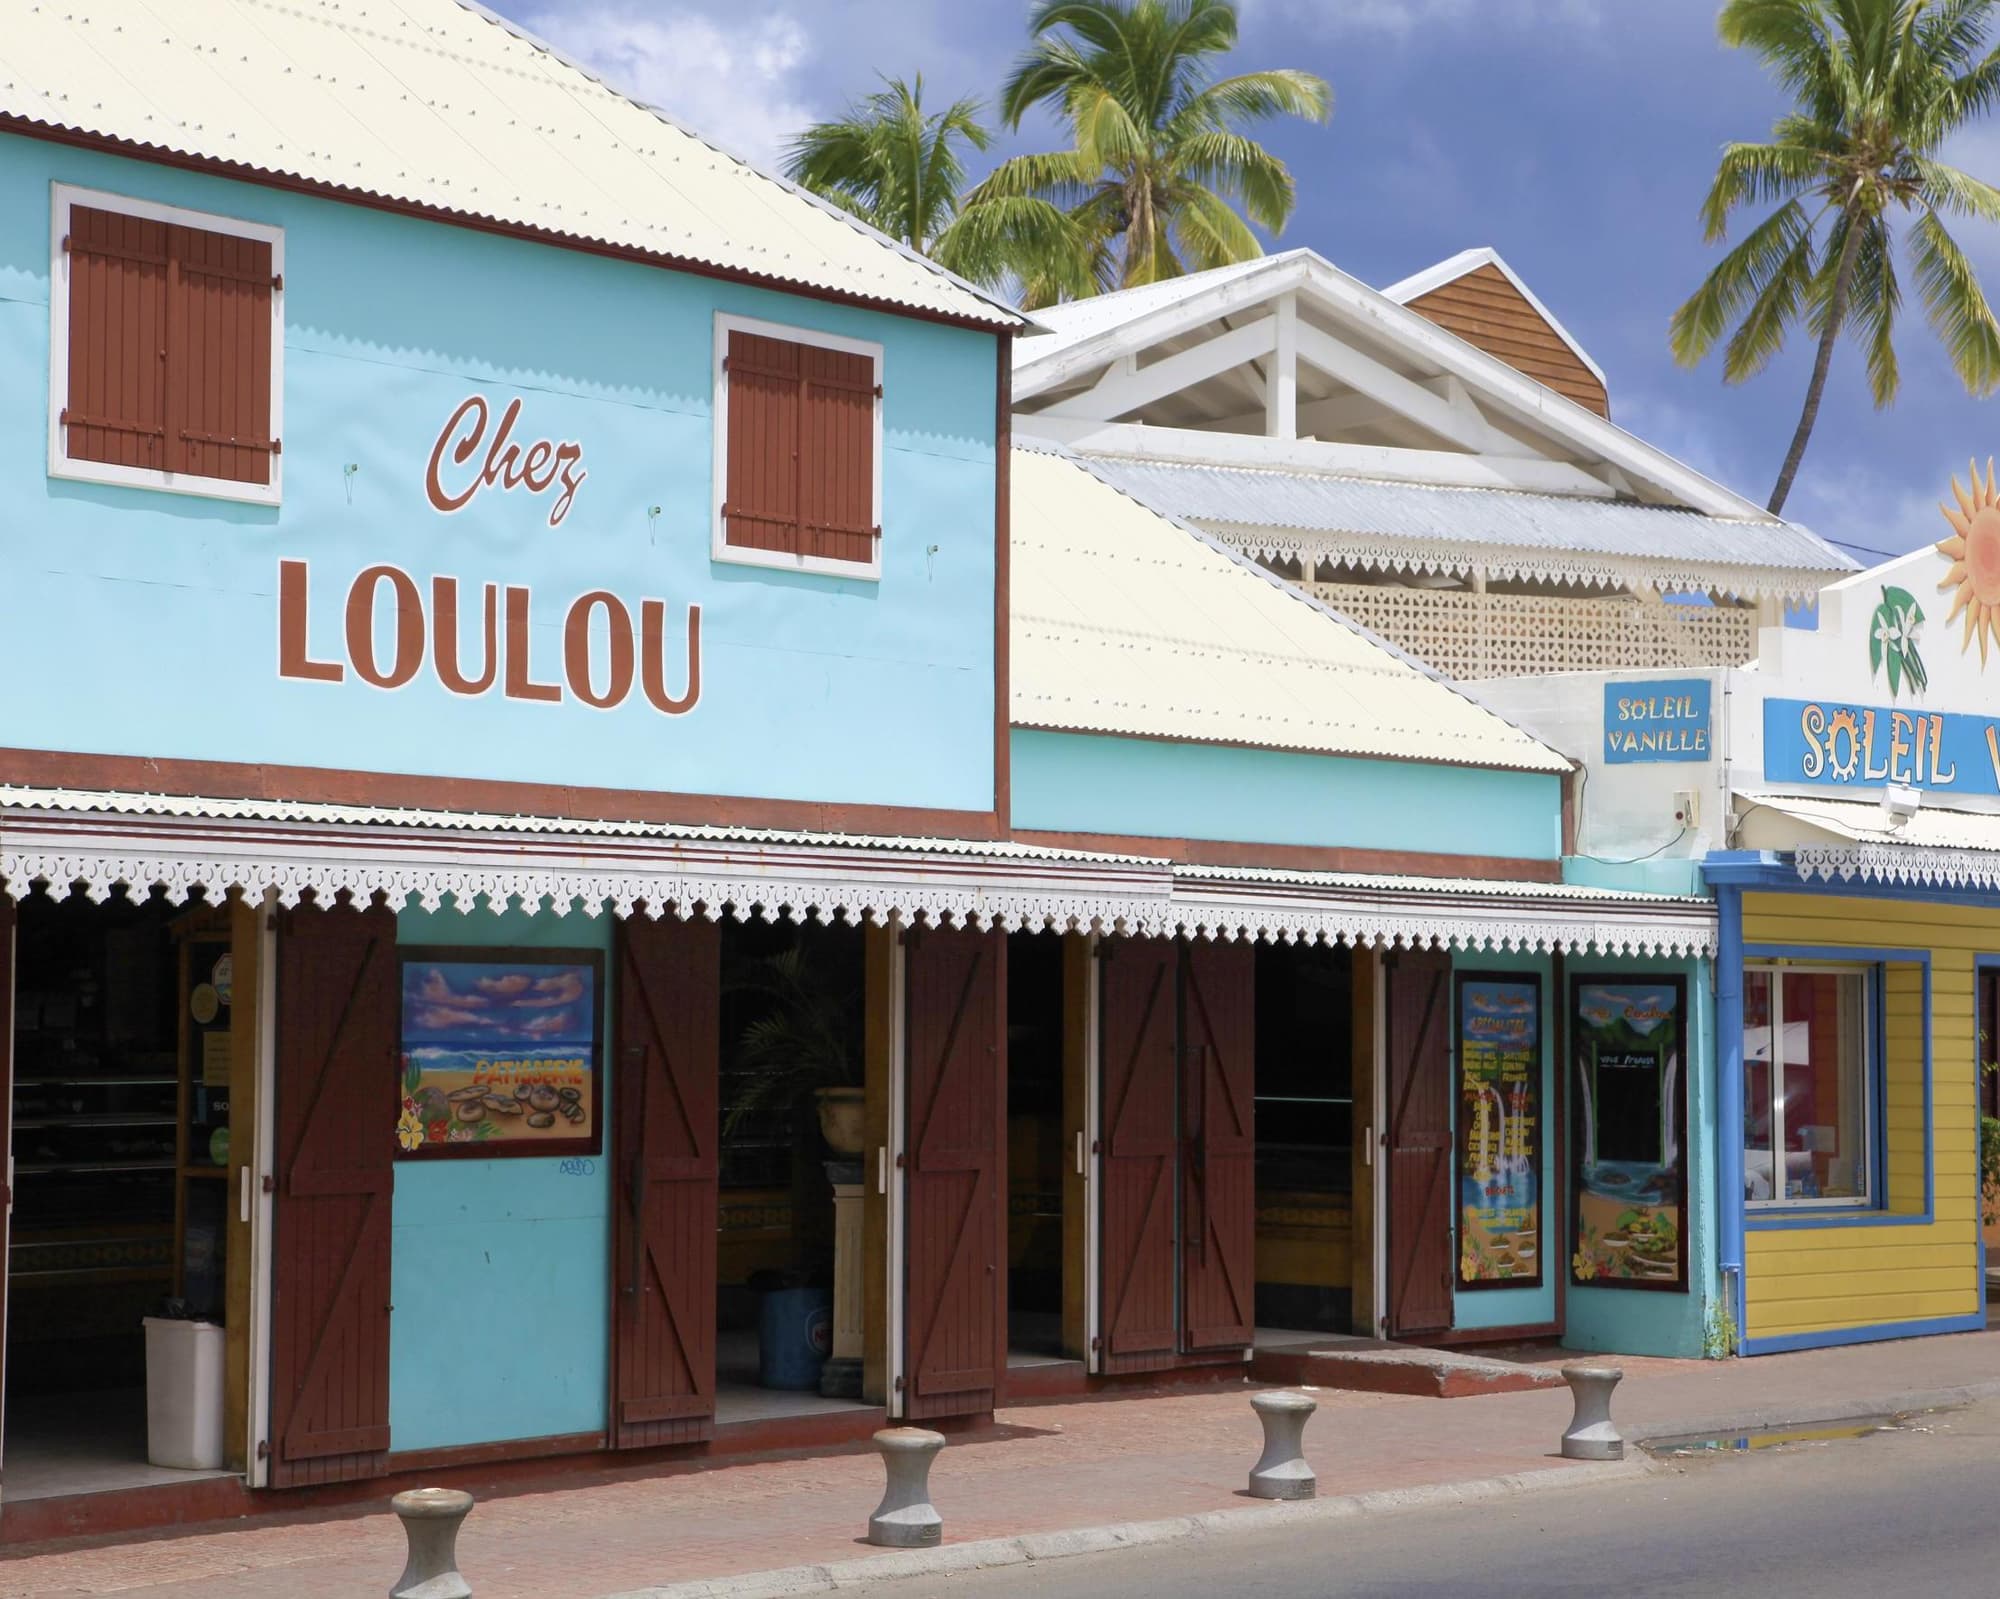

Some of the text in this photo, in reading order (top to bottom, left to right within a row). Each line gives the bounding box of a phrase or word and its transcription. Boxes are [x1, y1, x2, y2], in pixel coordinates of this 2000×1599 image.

[425, 396, 586, 527] Chez
[279, 558, 702, 715] LOULOU
[1618, 695, 1698, 722] SOLEIL
[1608, 727, 1706, 753] VANILLE
[1800, 703, 1956, 785] SOLEIL
[473, 1059, 584, 1085] PATISSERIE
